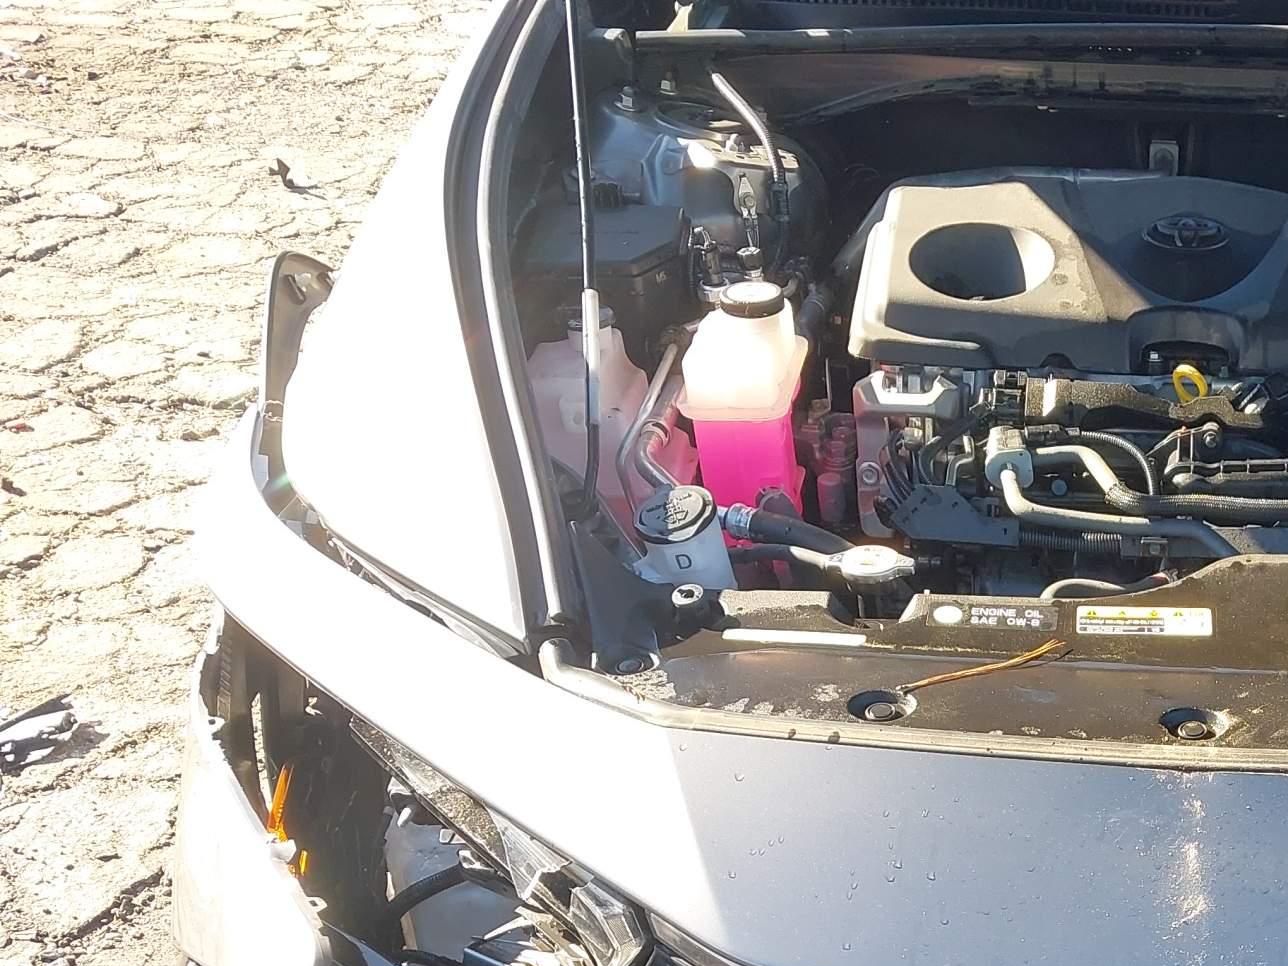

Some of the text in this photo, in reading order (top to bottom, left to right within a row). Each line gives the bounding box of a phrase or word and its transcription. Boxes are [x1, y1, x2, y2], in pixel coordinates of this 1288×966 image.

[675, 554, 692, 569] D
[971, 607, 1043, 619] ENGINE OIL
[970, 617, 997, 625] SAE
